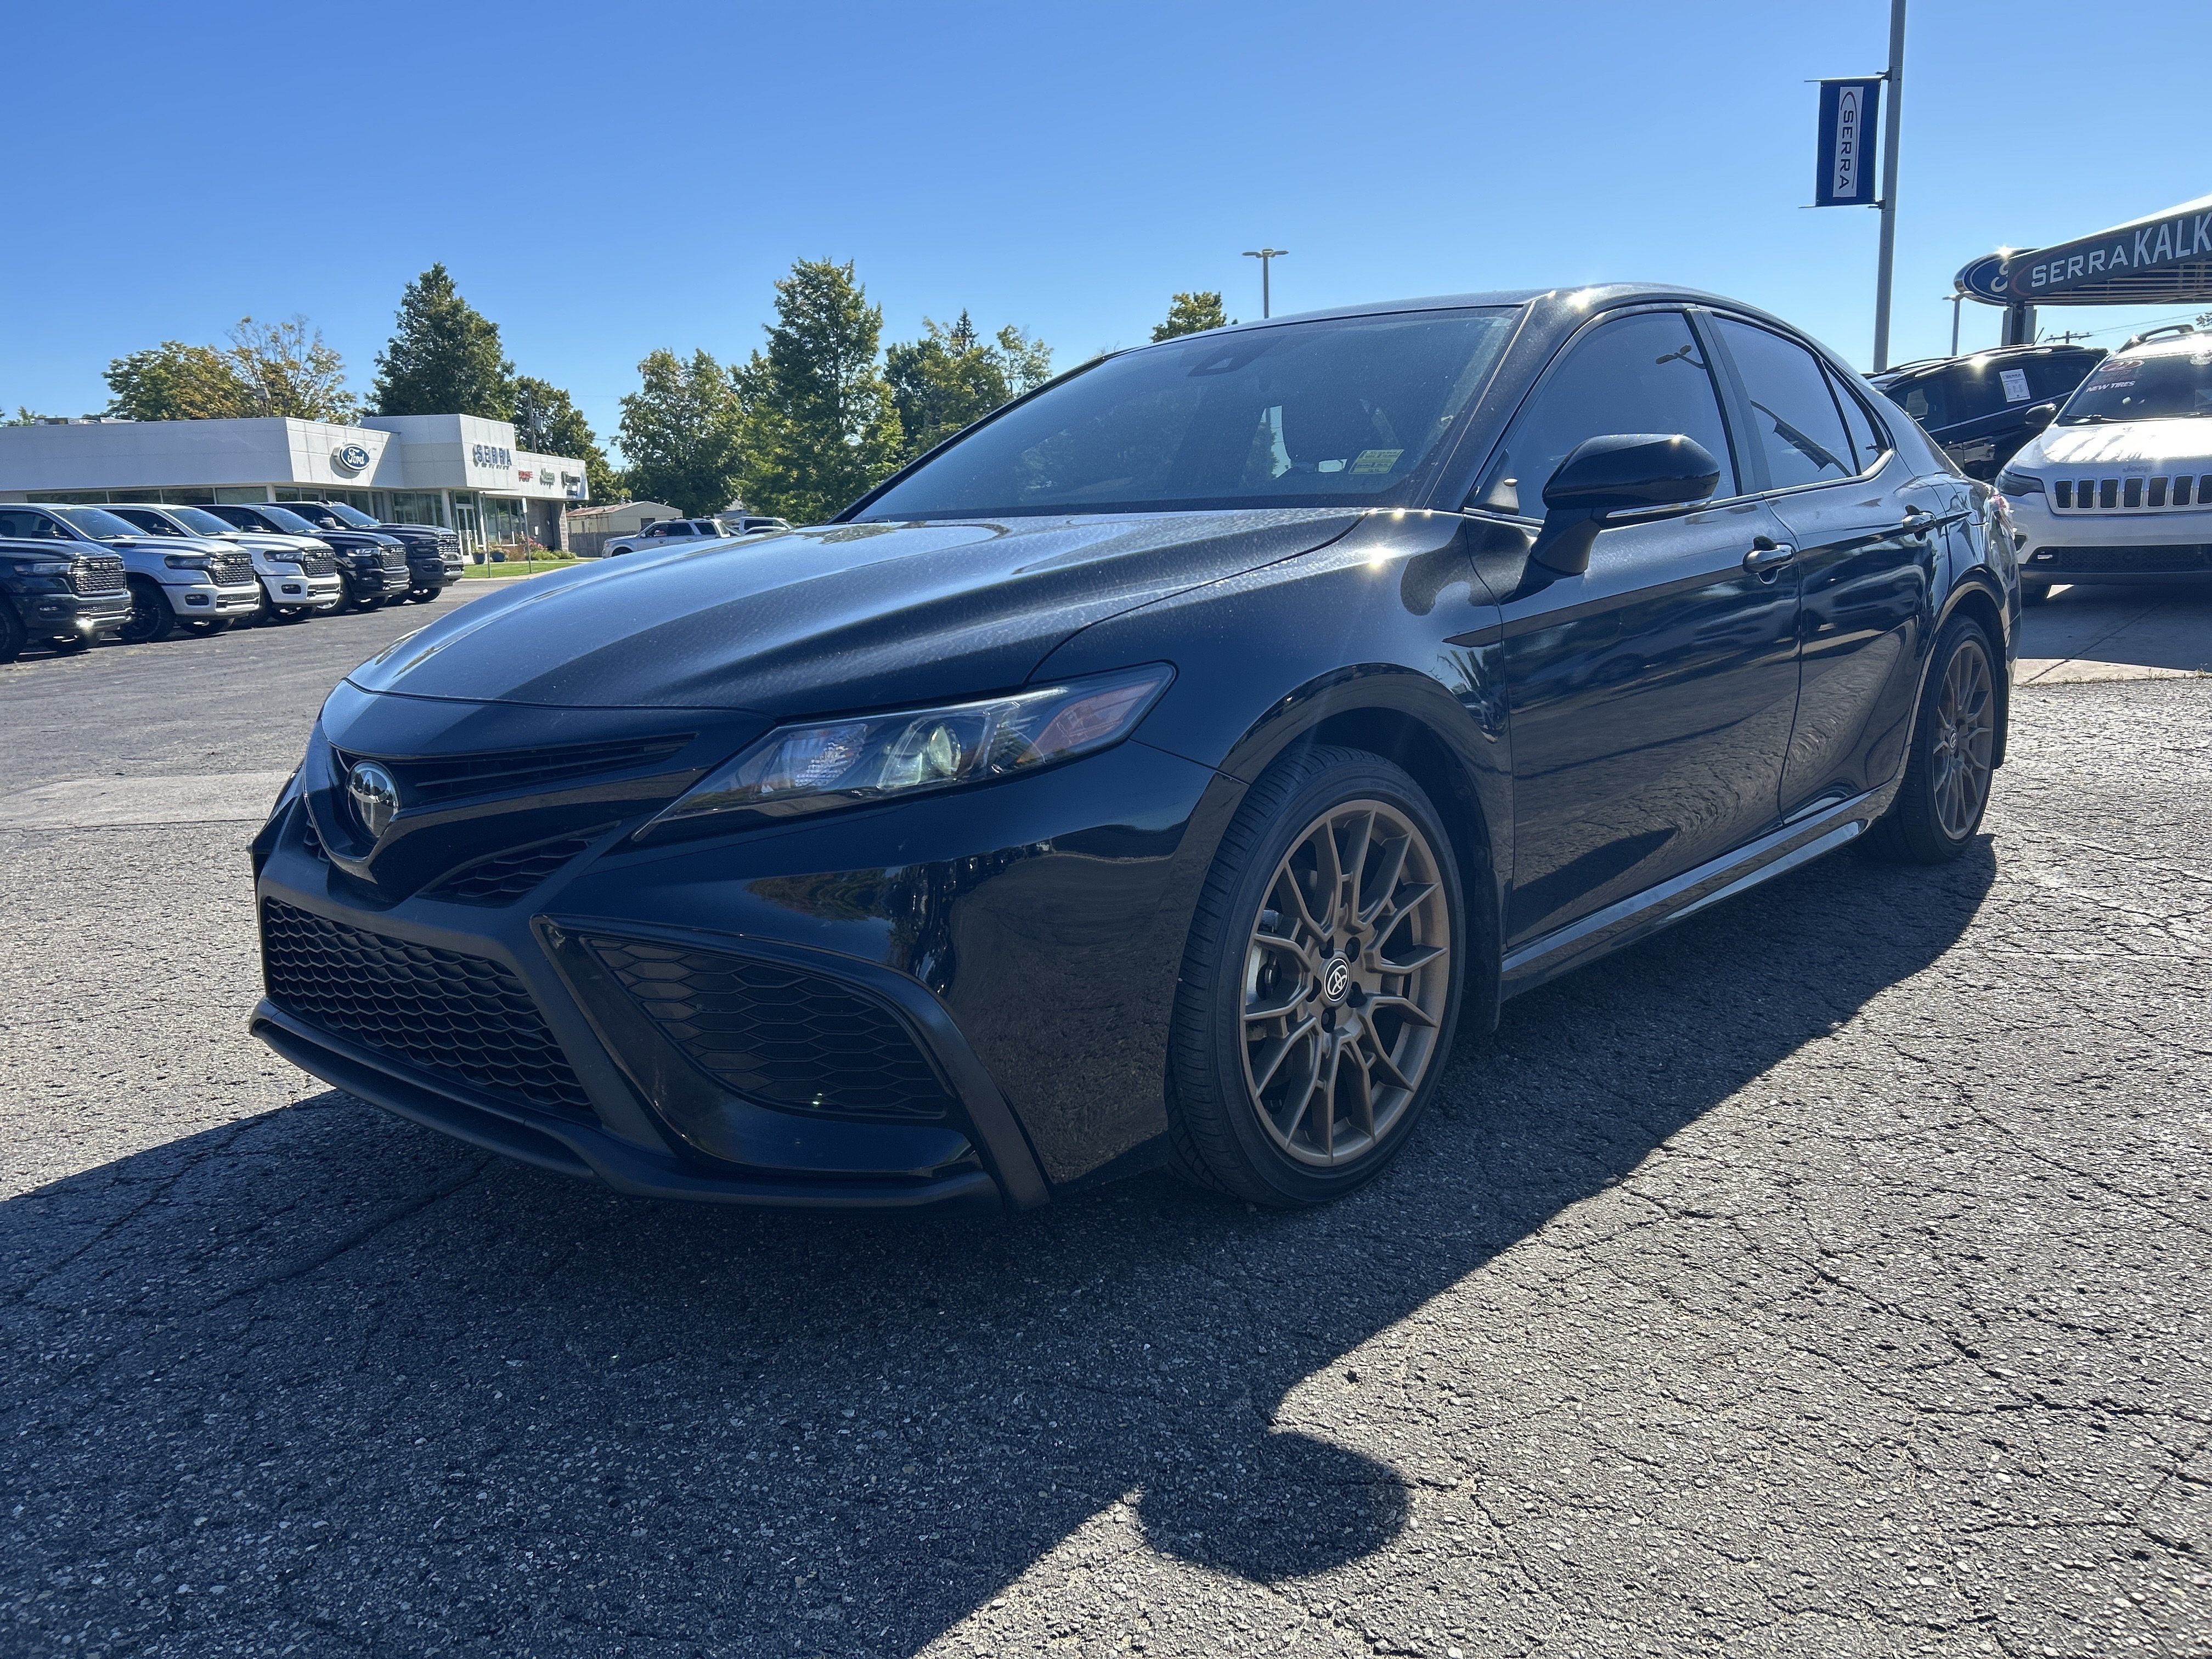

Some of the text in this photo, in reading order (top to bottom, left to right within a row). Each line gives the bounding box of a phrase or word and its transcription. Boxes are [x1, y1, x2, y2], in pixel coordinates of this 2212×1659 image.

[1839, 110, 1853, 189] SERRA
[2031, 245, 2129, 287] SERRA
[2086, 384, 2111, 393] NEW
[348, 448, 365, 465] Ford
[476, 444, 512, 466] SERRA
